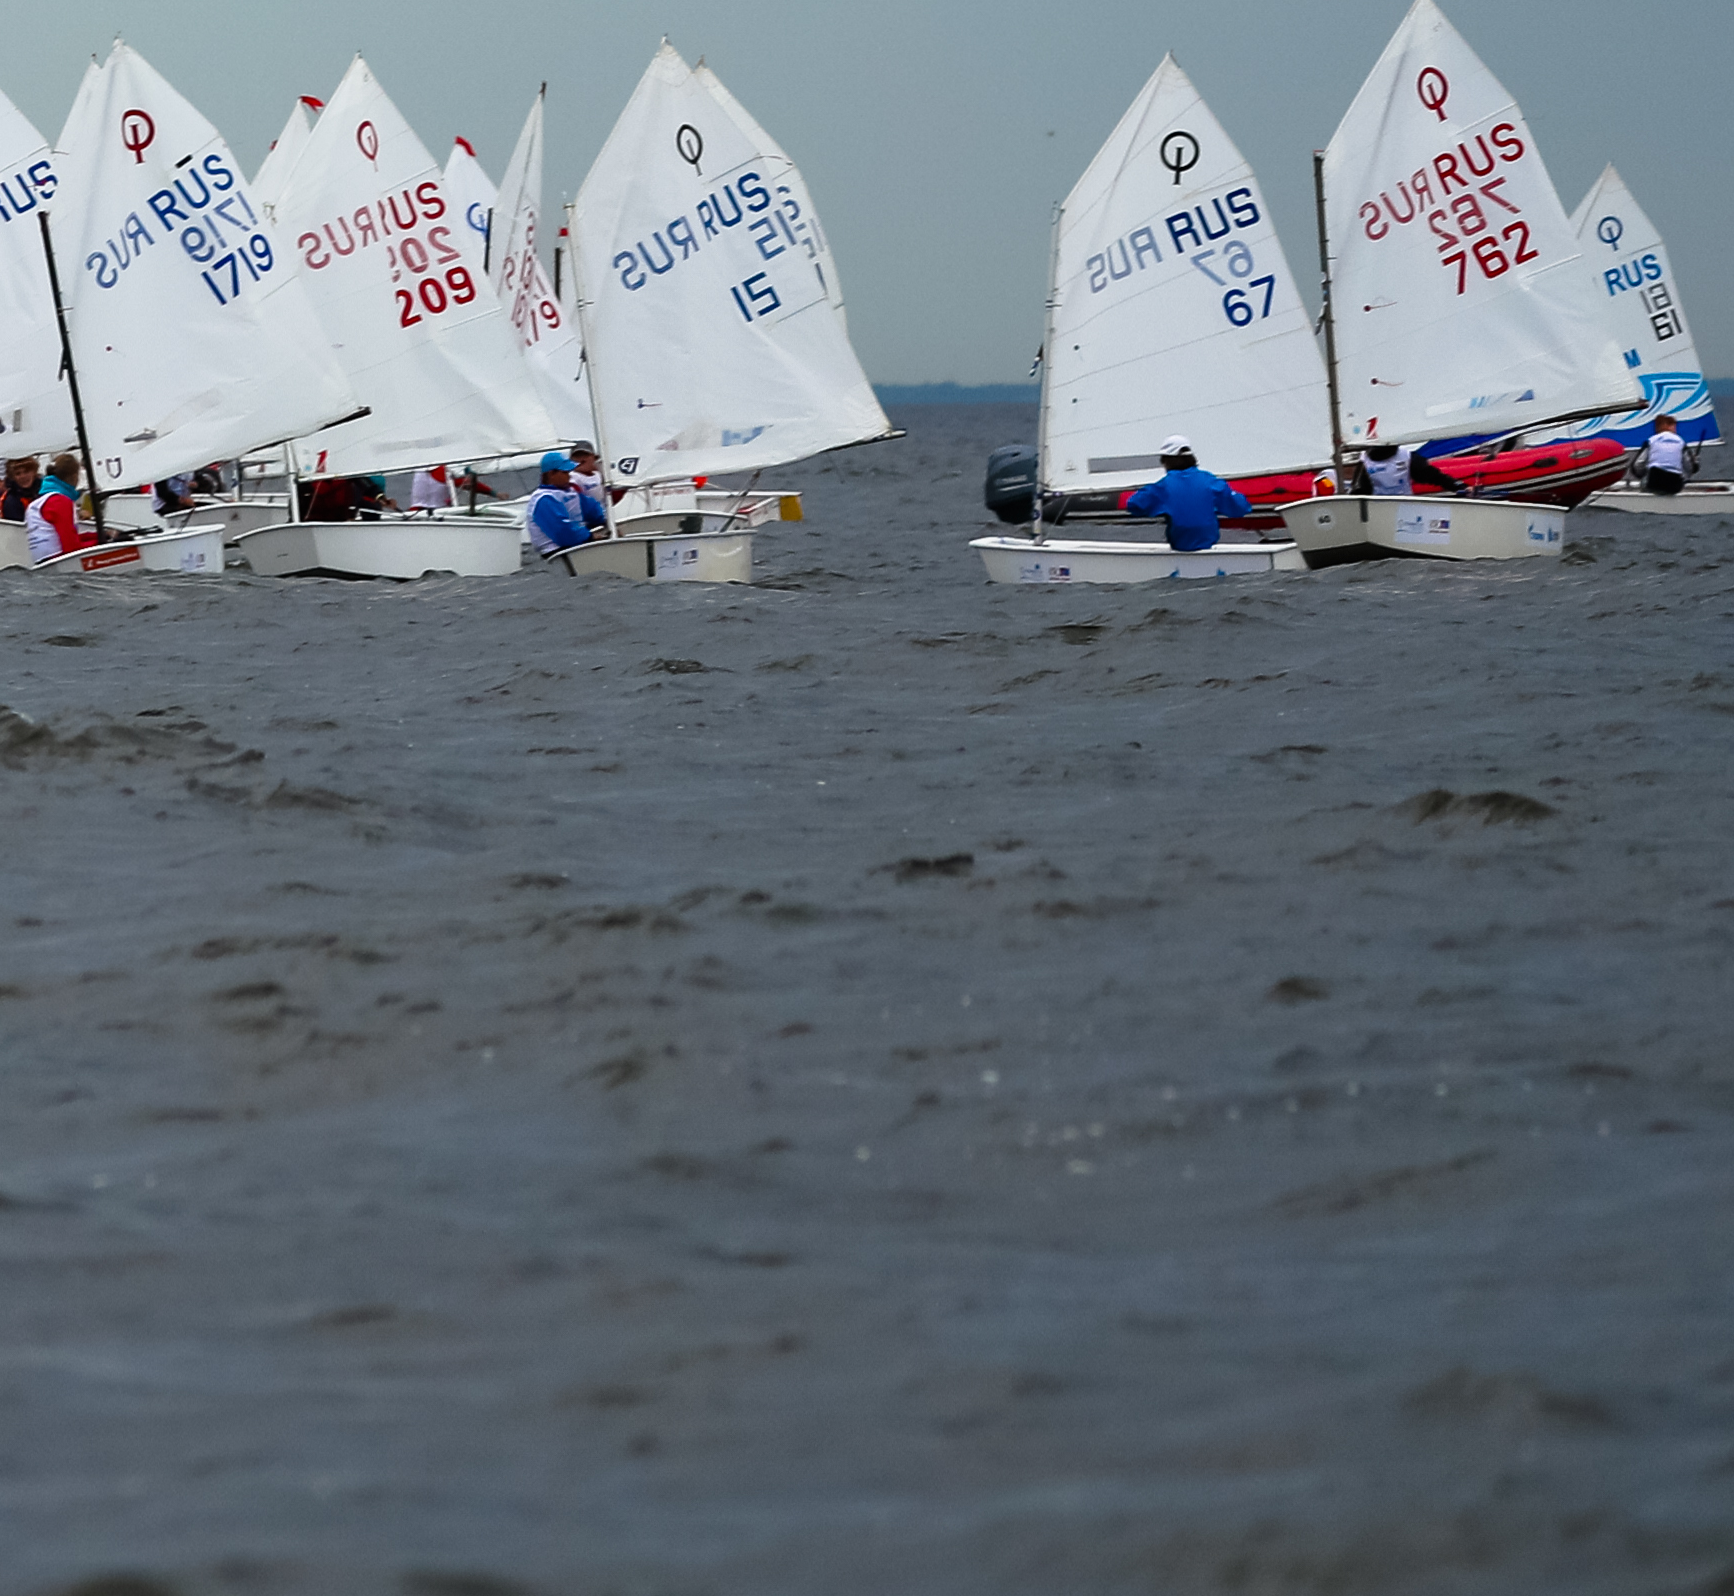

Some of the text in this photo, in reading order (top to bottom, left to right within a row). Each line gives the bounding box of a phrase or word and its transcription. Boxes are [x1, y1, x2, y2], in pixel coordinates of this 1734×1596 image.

[146, 153, 233, 232] RUS
[1432, 121, 1526, 197] RUS
[696, 172, 771, 242] RUS
[1166, 186, 1261, 254] RUS
[200, 232, 273, 306] 1719
[1440, 220, 1539, 296] 762
[1603, 254, 1662, 297] RUS
[395, 266, 477, 328] 209
[731, 271, 782, 322] 15
[1222, 275, 1276, 327] 67
[1649, 308, 1683, 341] 61
